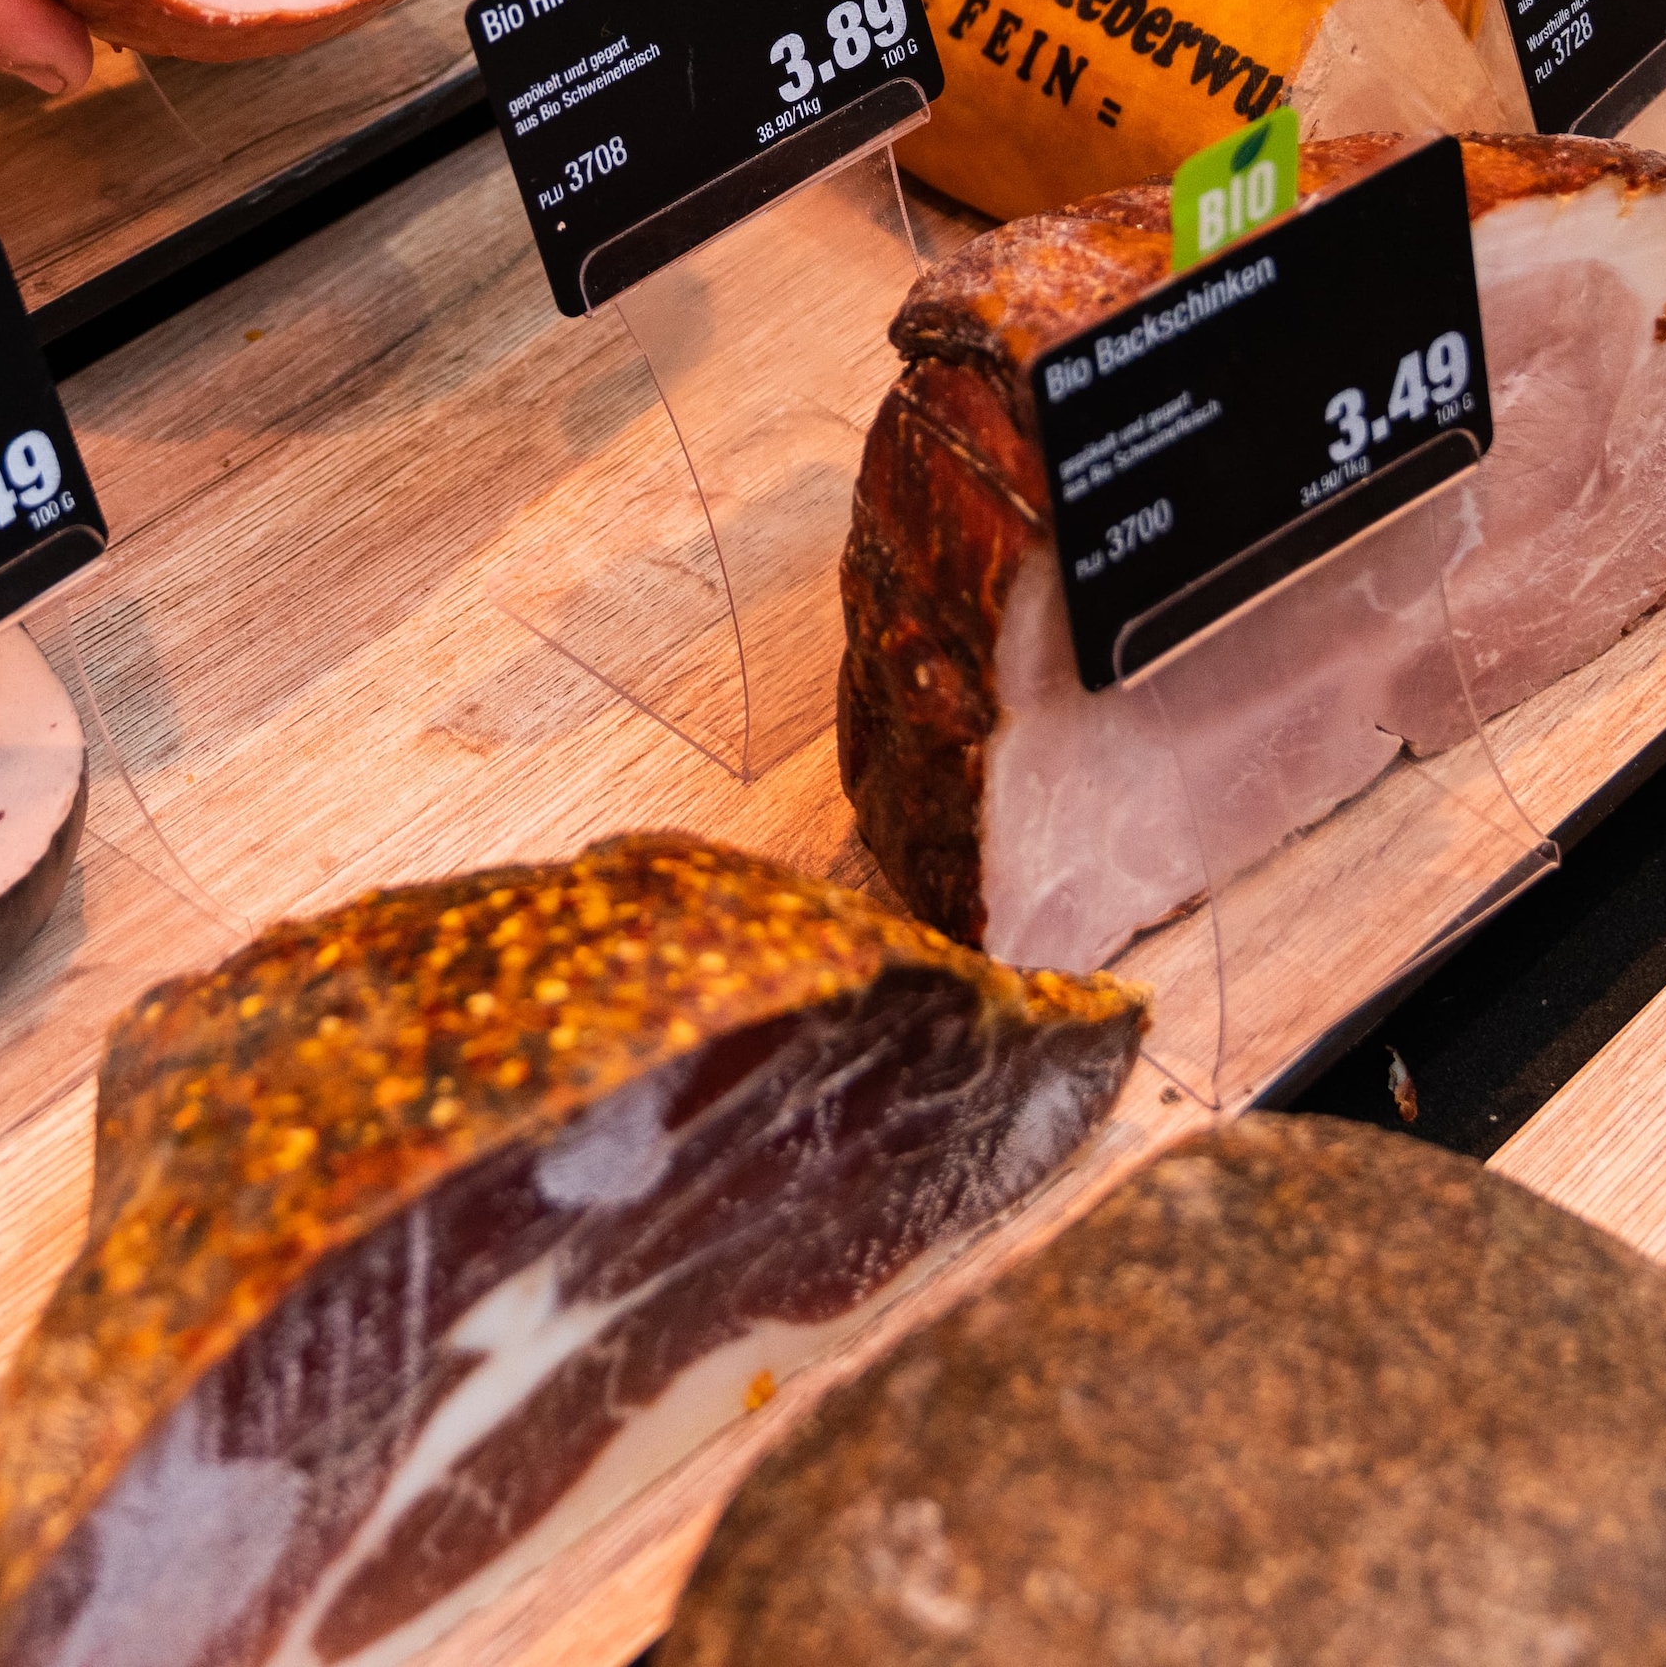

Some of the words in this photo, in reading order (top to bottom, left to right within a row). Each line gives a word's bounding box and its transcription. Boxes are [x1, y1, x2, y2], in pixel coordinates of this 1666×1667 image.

[480, 0, 525, 44] Bio
[881, 44, 906, 70] 100
[906, 37, 919, 55] G
[1526, 7, 1570, 53] Wursthülle
[1535, 59, 1553, 84] PLU
[1551, 11, 1594, 66] 3728
[508, 73, 564, 118] gepökelt
[563, 58, 589, 84] und
[589, 35, 631, 72] gegart
[515, 113, 540, 136] aus
[539, 101, 562, 123] Bio
[562, 42, 661, 109] Schweinefleisch
[756, 96, 821, 144] 38.90/1kg
[538, 183, 565, 211] PLU
[564, 135, 628, 192] 3708
[1196, 159, 1278, 256] BIO
[1044, 355, 1093, 404] Bio
[1094, 255, 1277, 377] Backschinken
[1324, 330, 1470, 464] 3.49
[1434, 401, 1460, 427] 100
[1461, 391, 1475, 413] G
[29, 500, 61, 531] 100
[60, 490, 77, 513] G
[1299, 455, 1371, 508] 34.90/1kg
[1075, 548, 1106, 581] PLU
[1105, 497, 1175, 563] 3700
